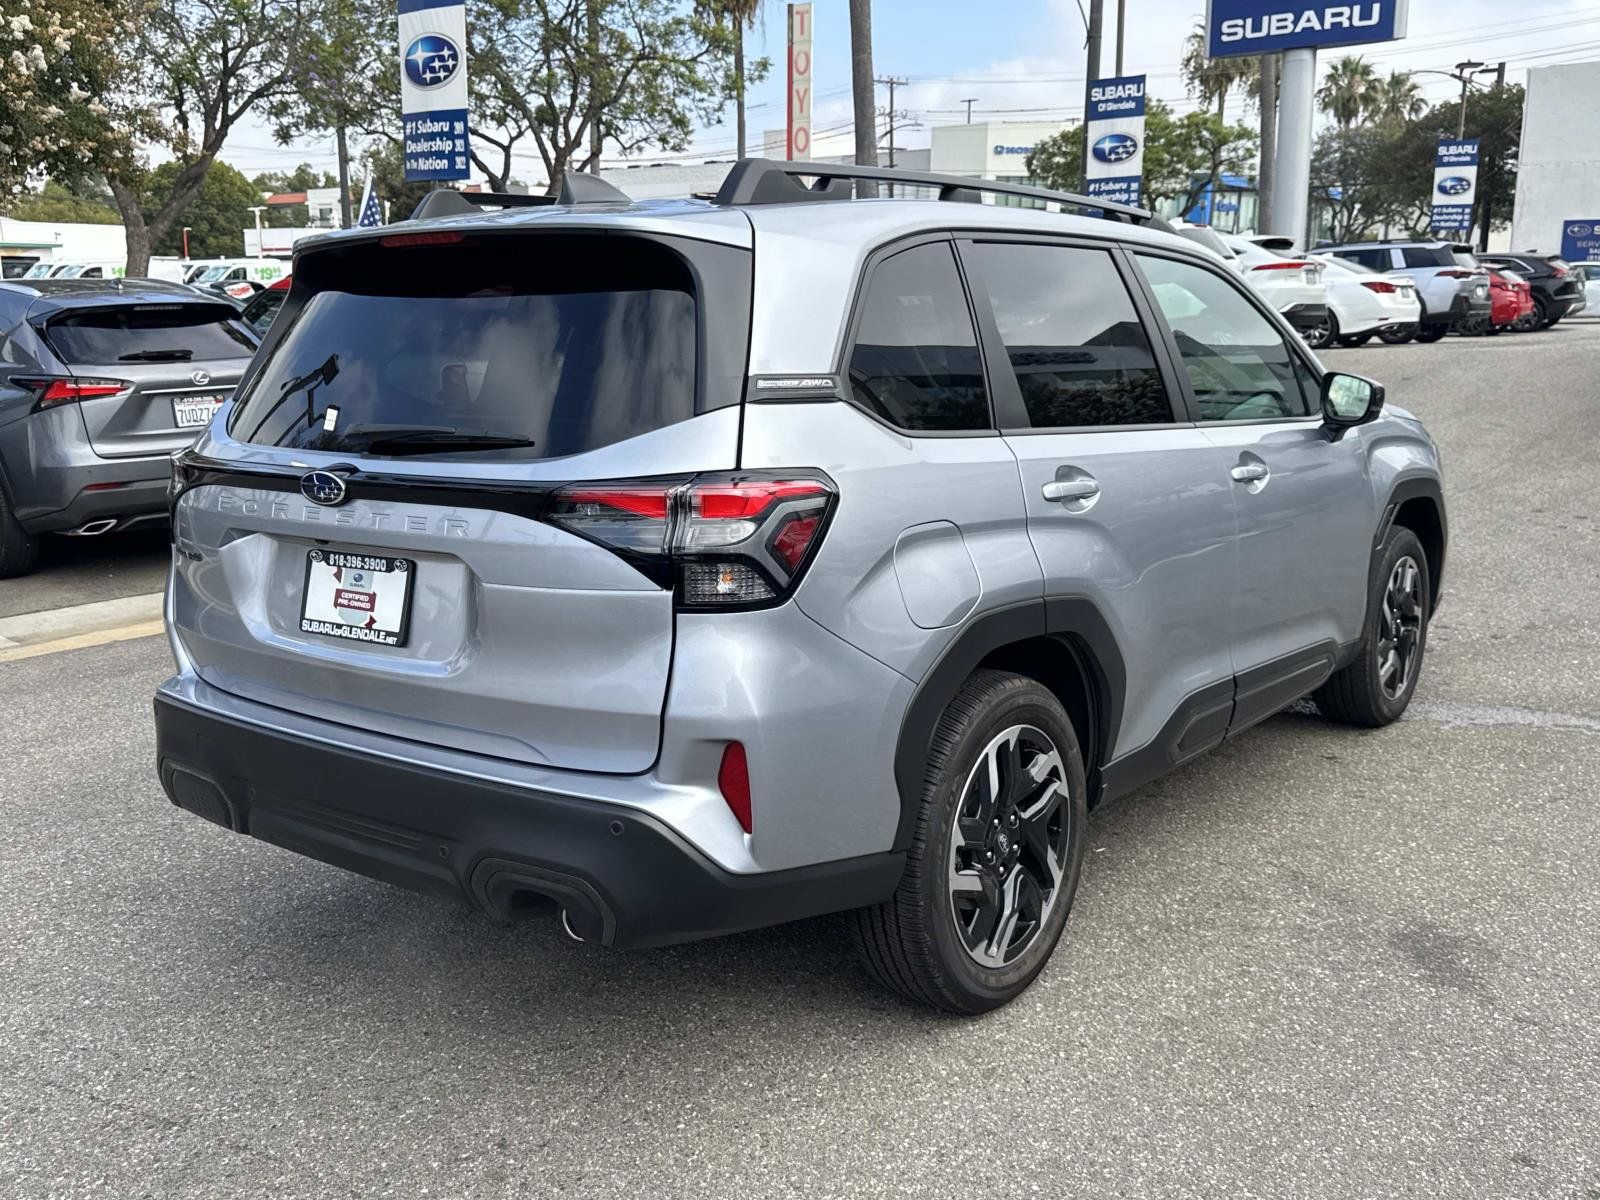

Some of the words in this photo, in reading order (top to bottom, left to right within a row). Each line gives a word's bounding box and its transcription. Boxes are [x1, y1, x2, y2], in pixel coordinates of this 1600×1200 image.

[1220, 3, 1381, 42] SUBARU
[1091, 83, 1144, 101] SUBARU
[1106, 100, 1136, 111] Glendale
[405, 121, 416, 135] #1
[417, 118, 450, 134] Subaru
[406, 136, 453, 154] Dealership
[1438, 144, 1478, 156] SUBARU
[417, 155, 449, 170] Nation
[1100, 181, 1128, 191] Subaru
[799, 379, 834, 388] AWD
[218, 496, 471, 537] FORESTER
[329, 553, 387, 572] 818-396-3900
[337, 598, 371, 609] PRE-OWNED
[341, 592, 370, 602] CERTIFIED
